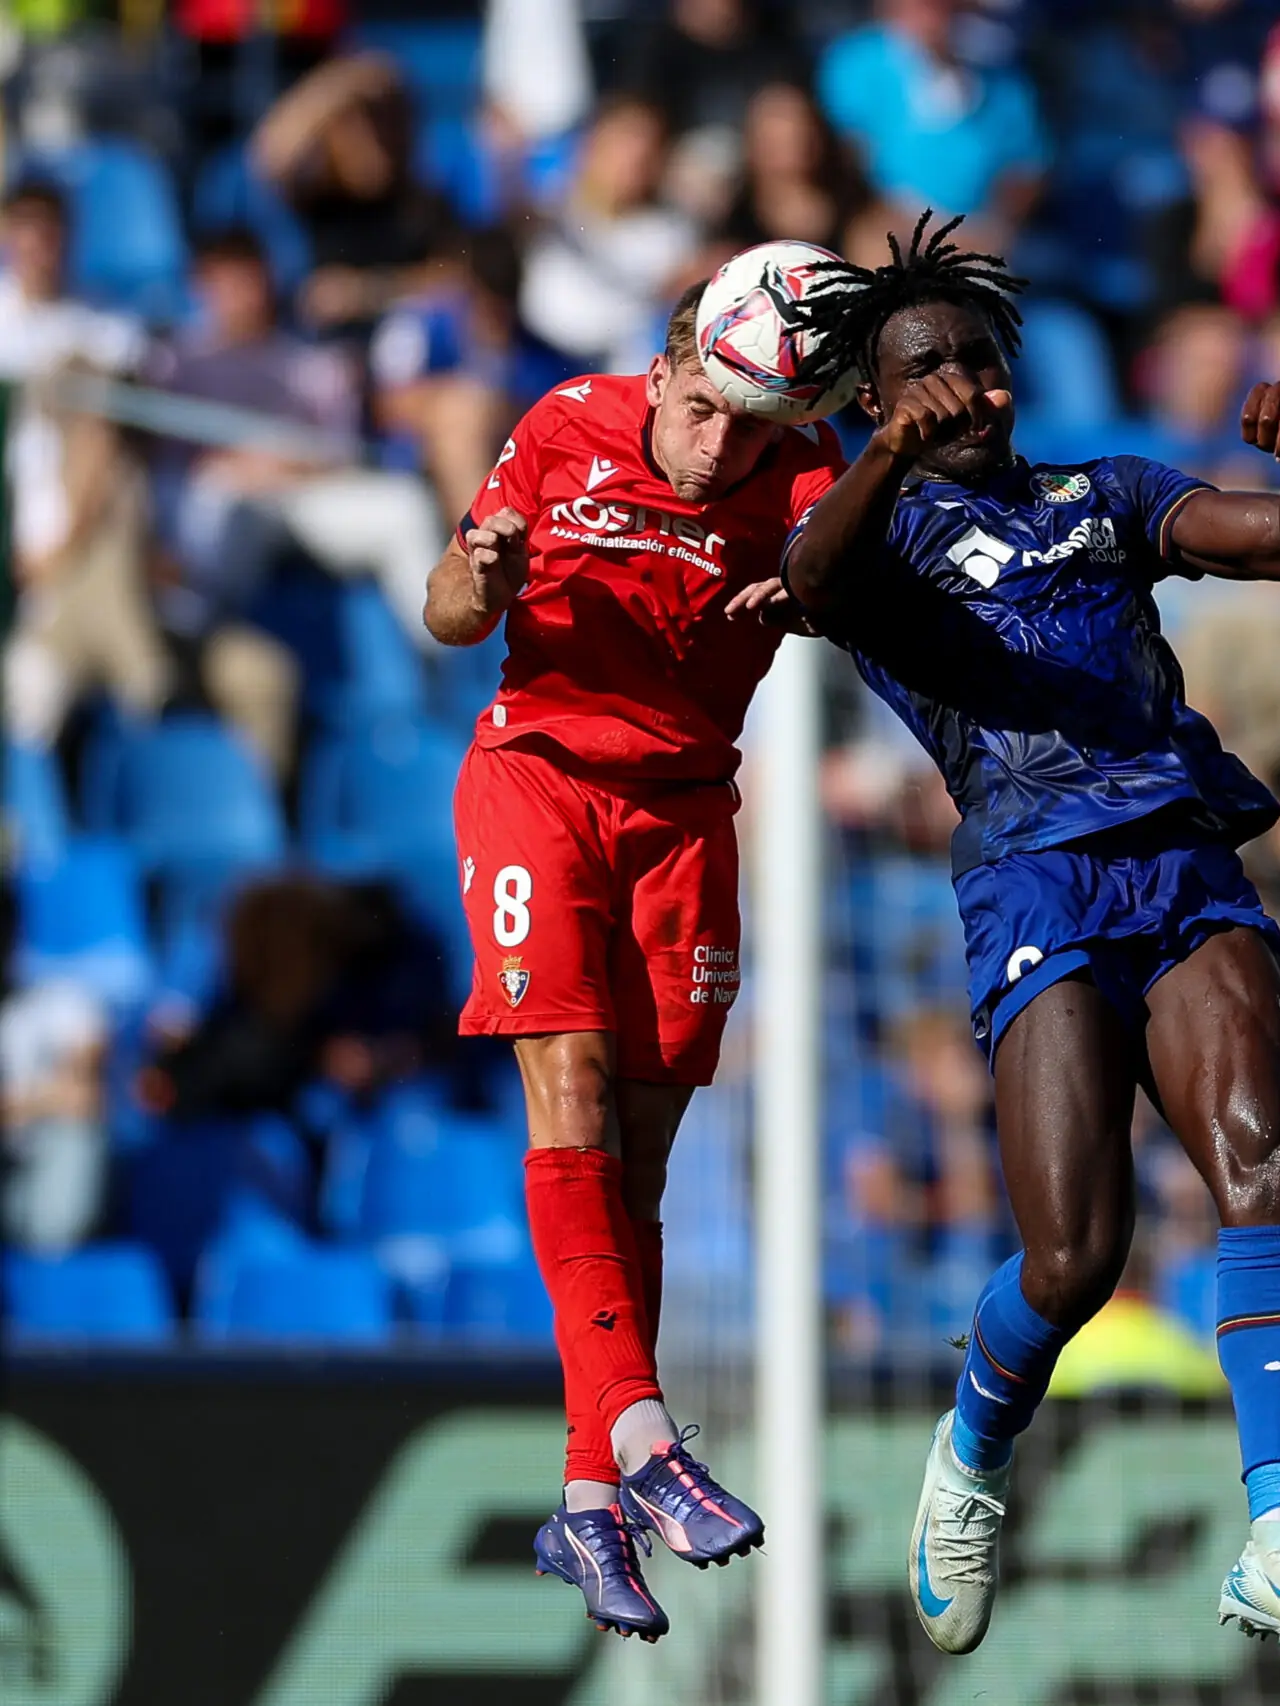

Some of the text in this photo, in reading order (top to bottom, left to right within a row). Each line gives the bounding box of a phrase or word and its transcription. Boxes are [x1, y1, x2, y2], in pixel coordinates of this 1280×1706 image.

[668, 545, 722, 577] eficiente
[493, 864, 533, 948] 8
[690, 986, 709, 1003] de
